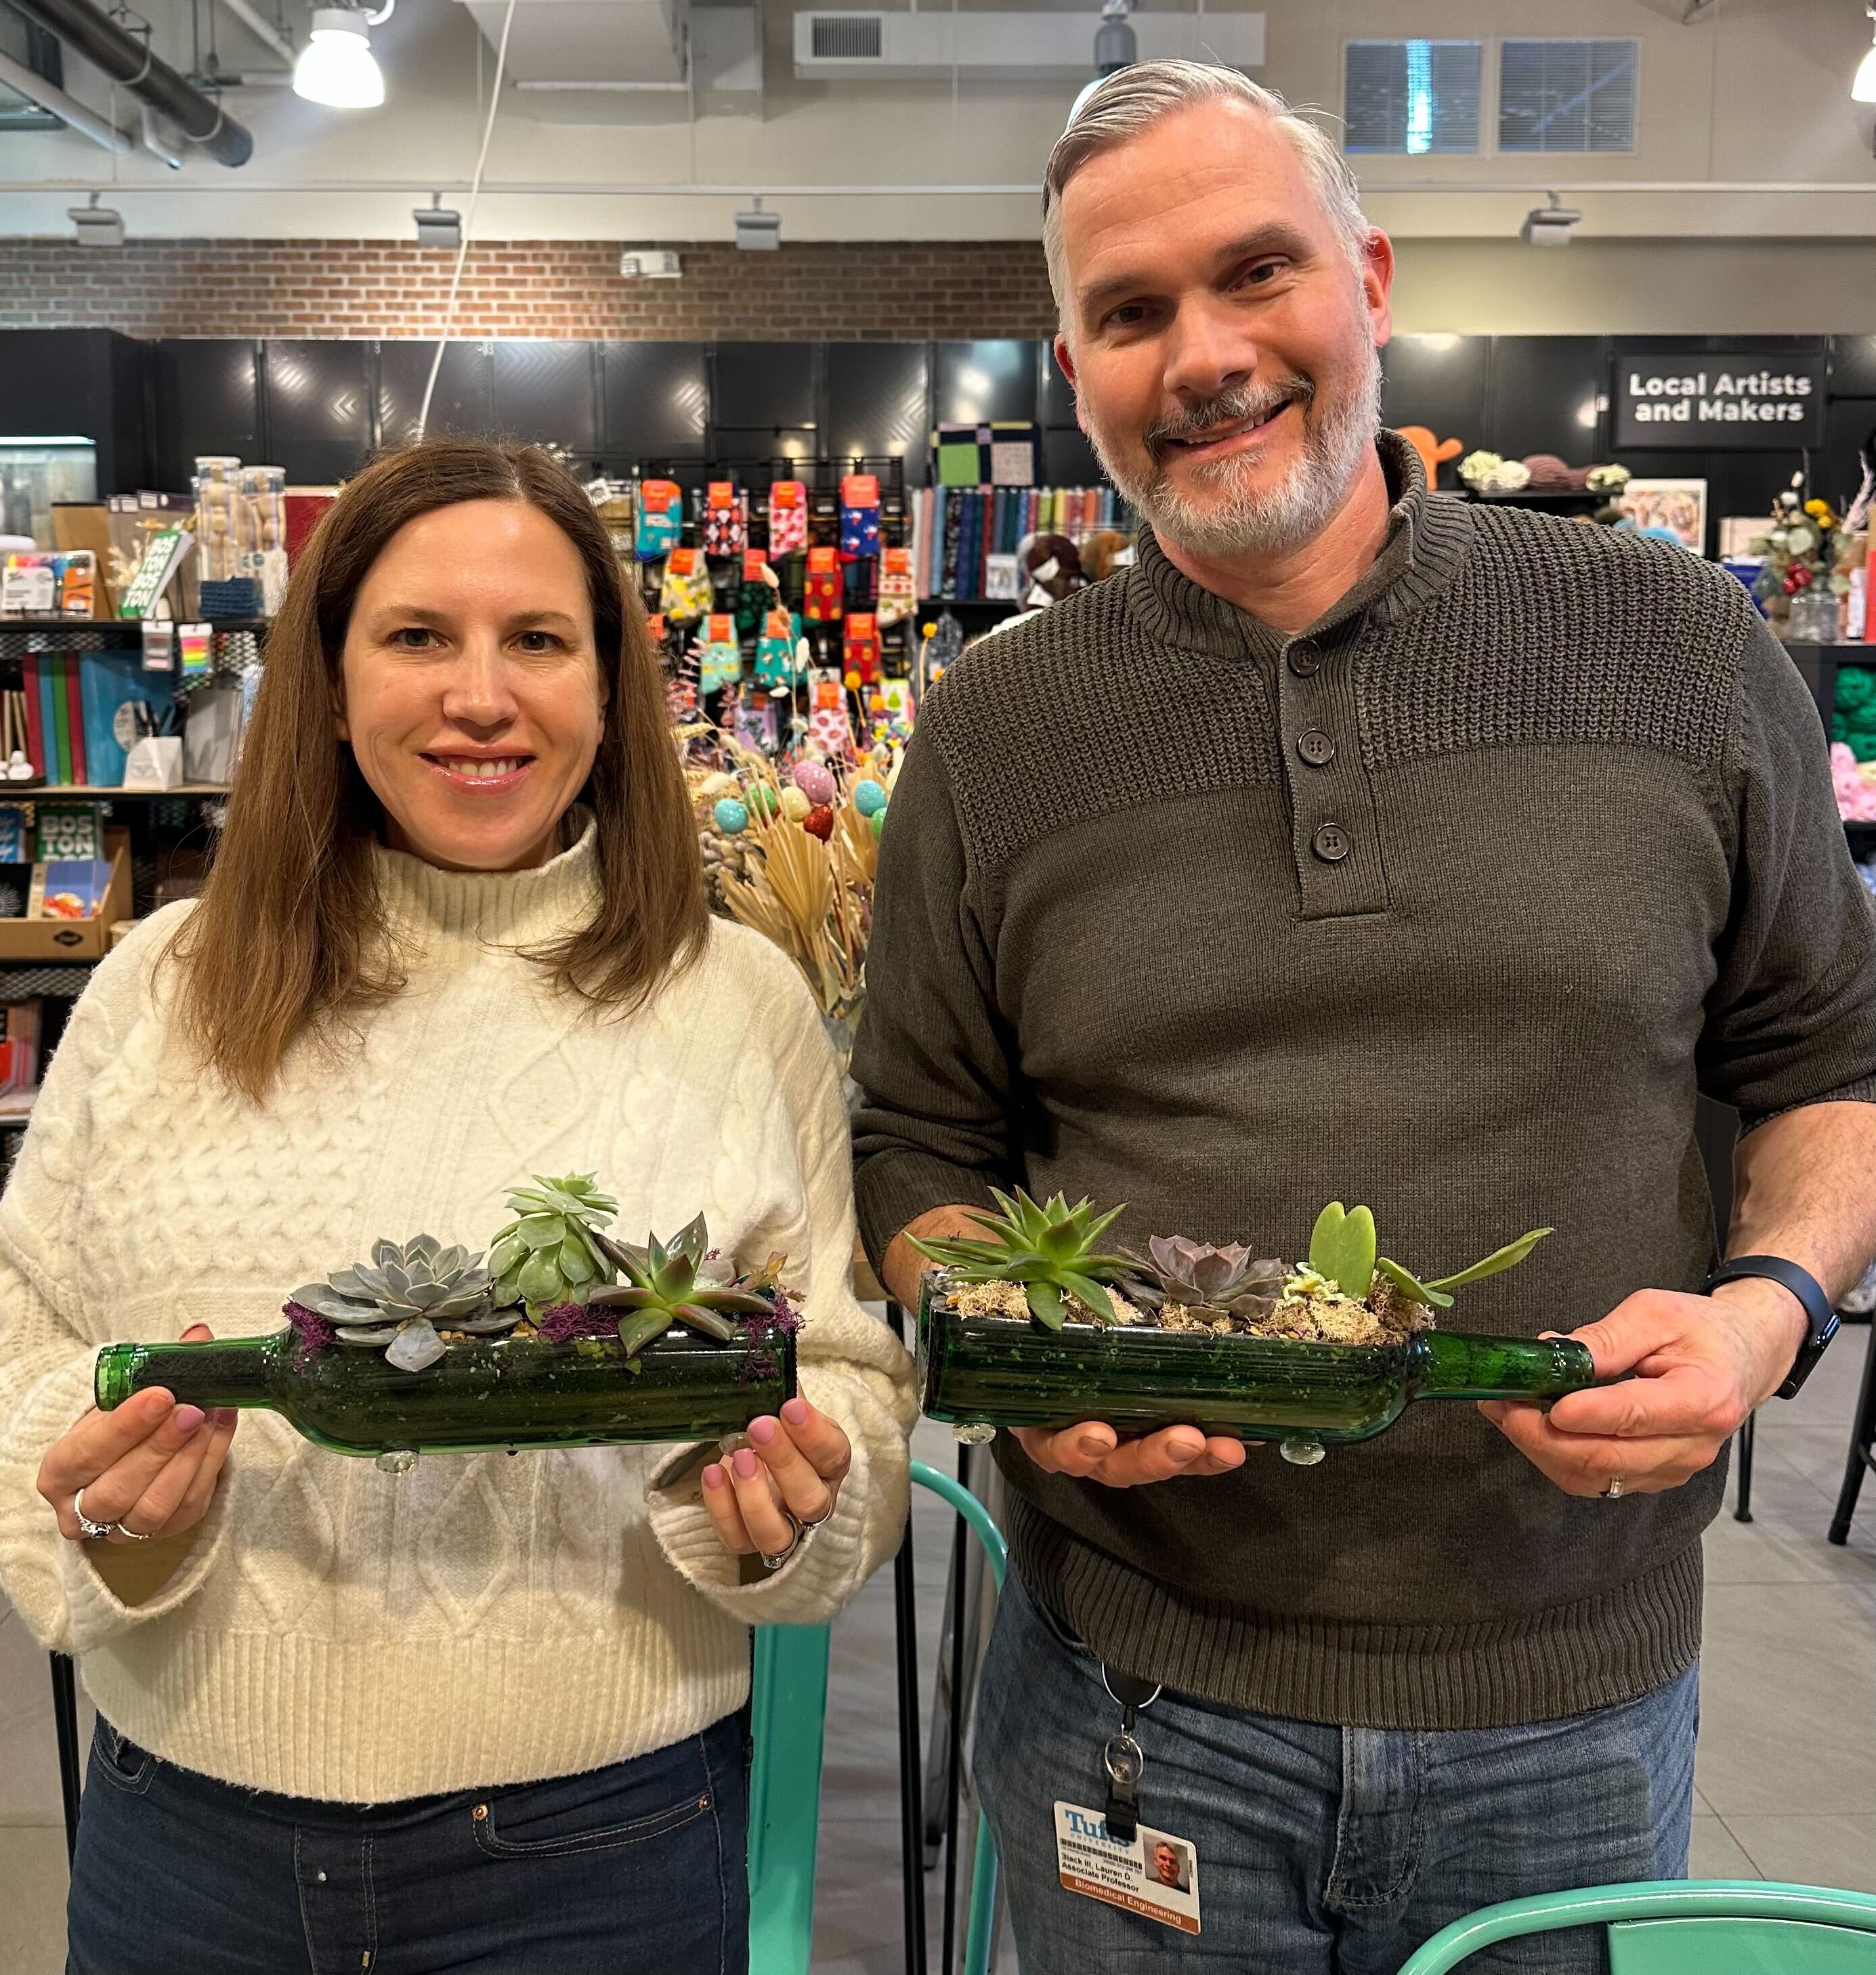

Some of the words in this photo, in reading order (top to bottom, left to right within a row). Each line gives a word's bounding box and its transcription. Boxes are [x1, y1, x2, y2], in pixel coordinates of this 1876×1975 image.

[1629, 372, 1707, 396] Local
[1713, 370, 1812, 396] Artists
[1634, 398, 1691, 422] and
[1698, 398, 1805, 422] Makers
[123, 589, 154, 608] TON
[41, 815, 93, 834] BOS
[41, 834, 93, 853] TON
[1065, 1809, 1130, 1848] Tuf
[1061, 1861, 1099, 1879] Associate
[1101, 1873, 1139, 1892] Professor
[1095, 1862, 1123, 1878] Lauren
[1075, 1878, 1126, 1904] Biomedical
[1127, 1896, 1182, 1925] Engineering
